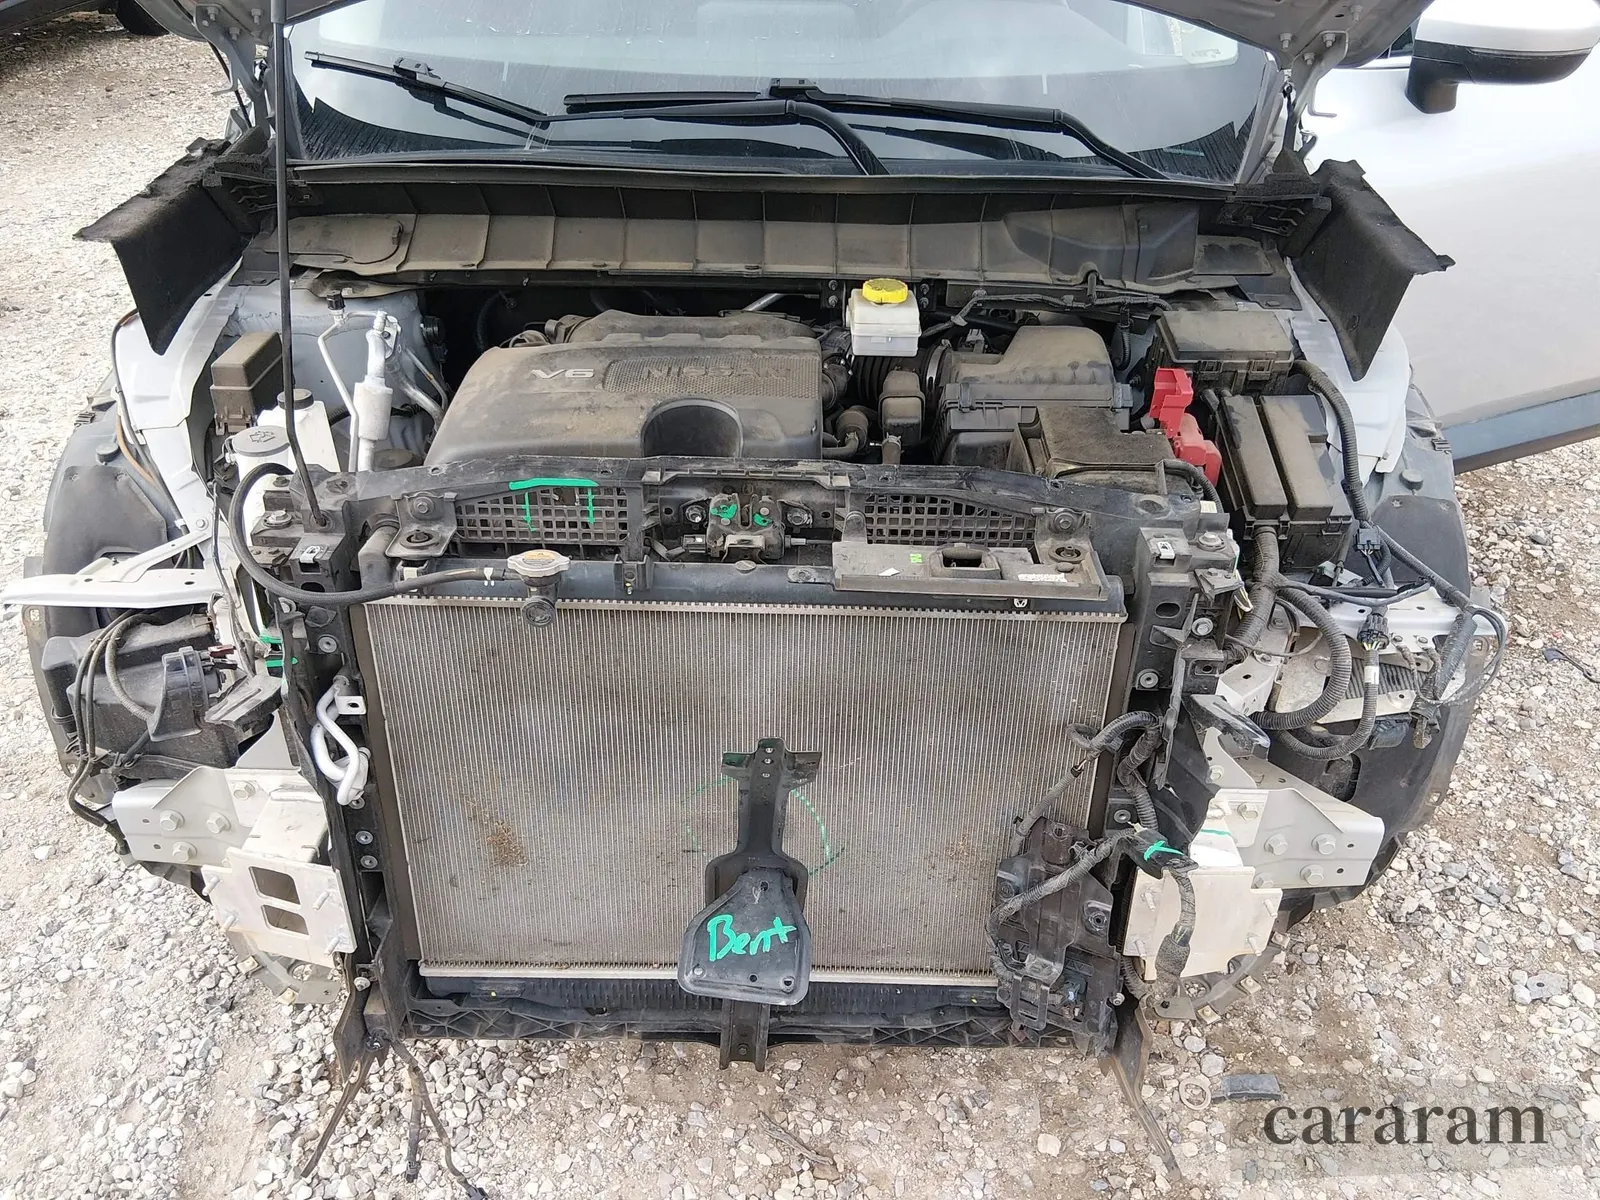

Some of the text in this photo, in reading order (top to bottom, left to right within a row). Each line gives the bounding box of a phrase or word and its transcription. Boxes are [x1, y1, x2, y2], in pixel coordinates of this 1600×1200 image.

[531, 368, 595, 379] V6
[642, 365, 791, 381] NISSAN
[707, 914, 797, 962] Bent
